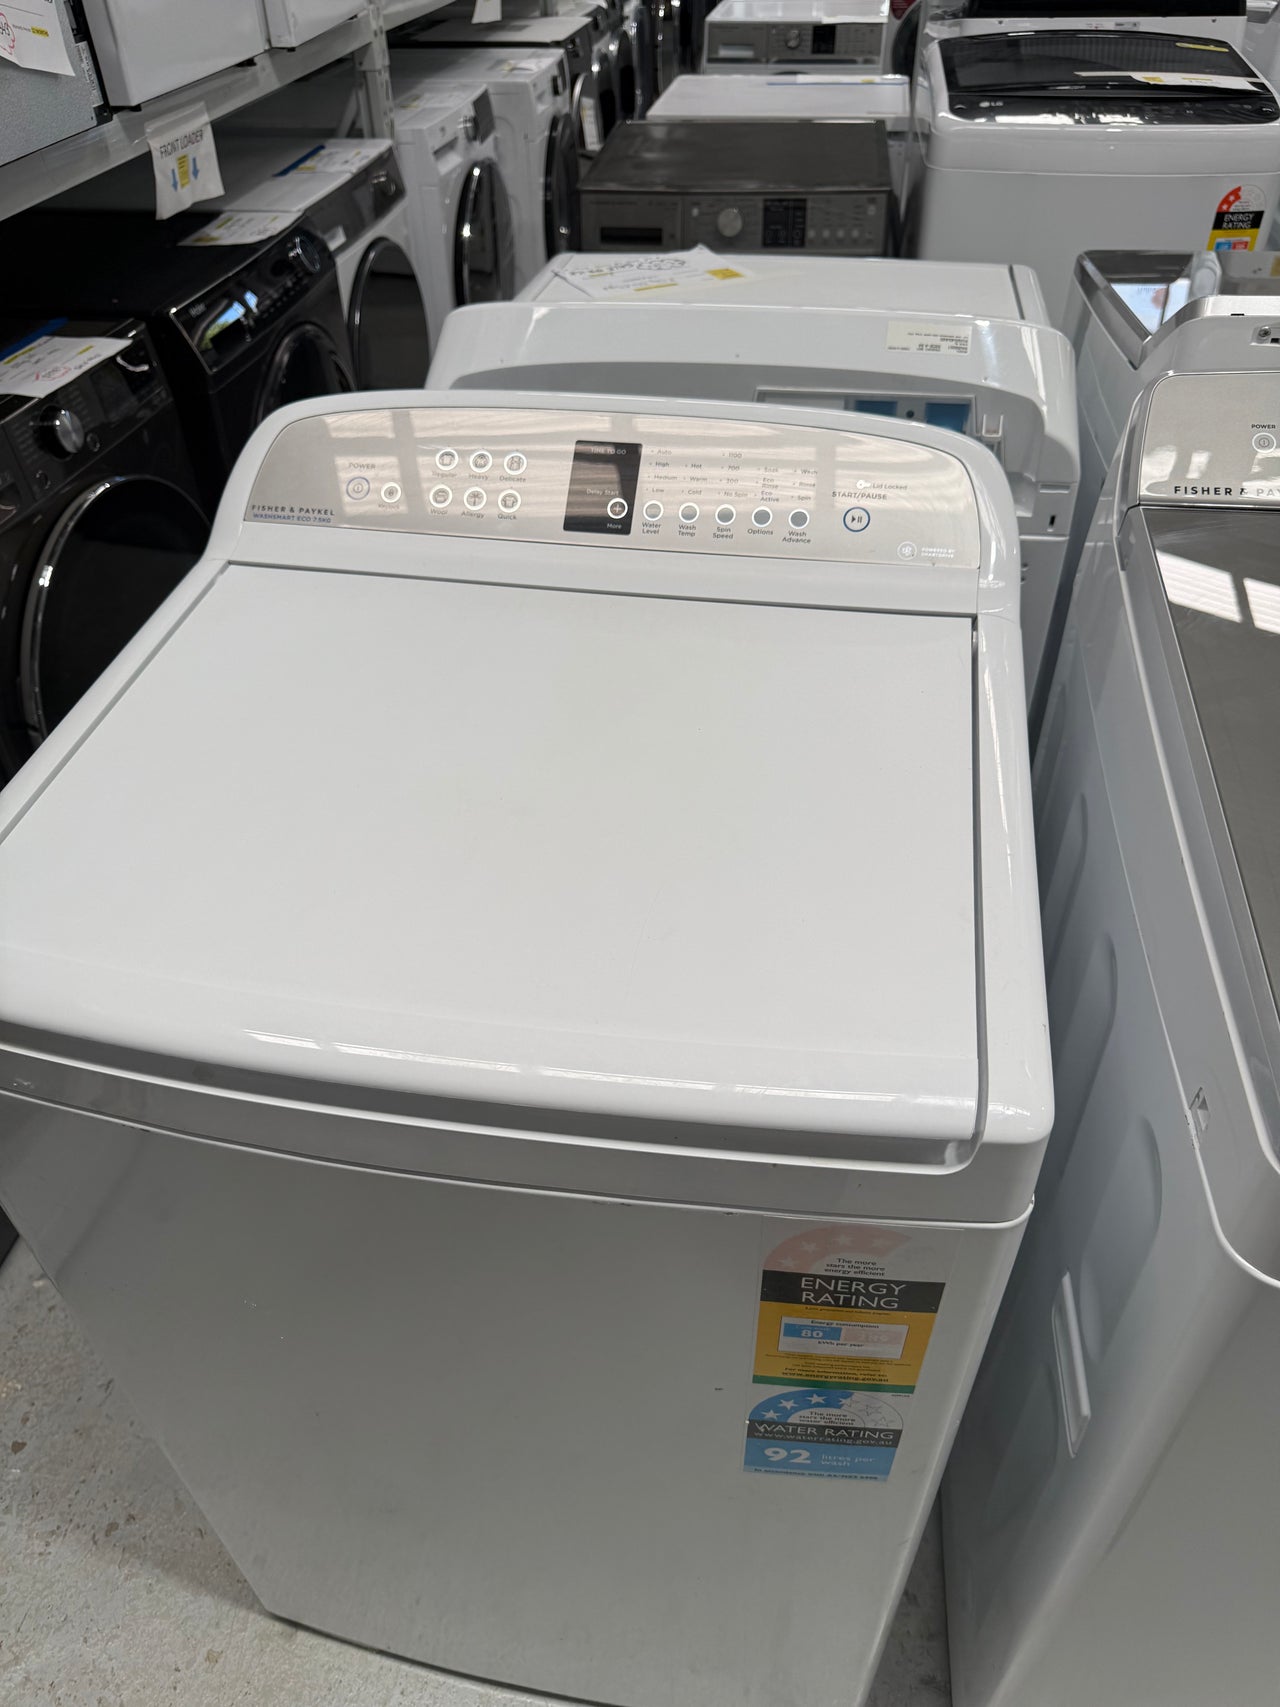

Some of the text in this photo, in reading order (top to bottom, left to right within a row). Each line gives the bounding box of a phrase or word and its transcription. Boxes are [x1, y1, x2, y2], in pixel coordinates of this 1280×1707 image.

[1224, 213, 1254, 222] ENERGY
[1222, 221, 1252, 229] RATING
[349, 462, 376, 470] POWER
[469, 473, 489, 481] Heavy
[586, 488, 604, 496] Delay
[832, 491, 888, 500] START/PAUSE
[1174, 486, 1233, 496] FISHER
[1239, 487, 1249, 495] &
[299, 507, 335, 516] PAYKEL
[461, 511, 485, 519] Allergy
[253, 513, 295, 521] WASHSMART
[678, 530, 696, 538] Temp
[782, 536, 811, 544] Advance
[801, 1277, 906, 1295] ENERGY
[802, 1291, 899, 1309] RATING
[801, 1329, 823, 1338] 80
[754, 1422, 894, 1440] WATER RATING
[754, 1432, 893, 1446] www.waterrating.gov.au
[764, 1447, 812, 1464] 92
[821, 1453, 852, 1462] litres
